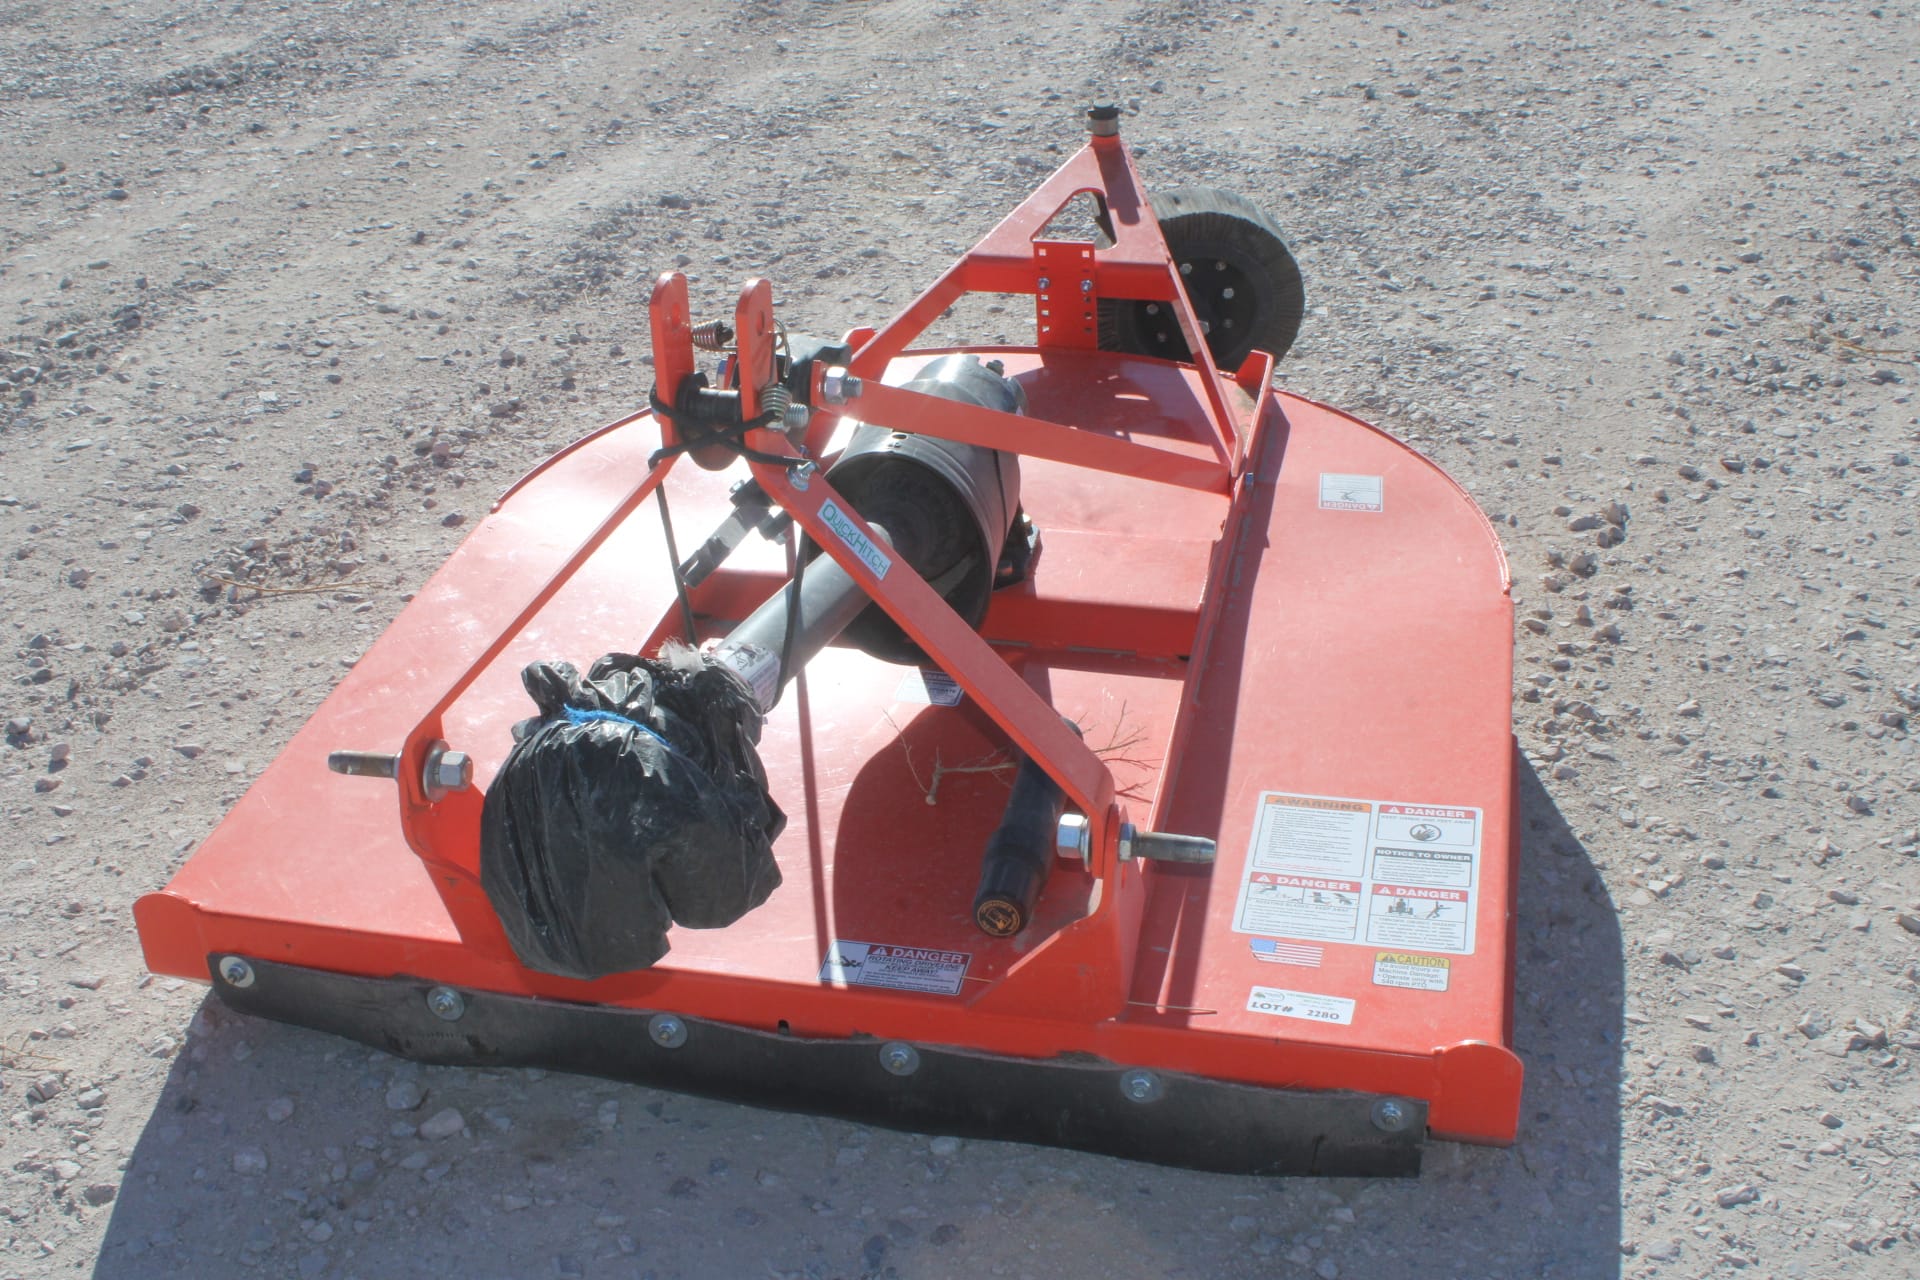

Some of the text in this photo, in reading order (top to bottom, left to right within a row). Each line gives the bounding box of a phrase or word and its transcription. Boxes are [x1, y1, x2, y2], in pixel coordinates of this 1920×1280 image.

[1288, 798, 1363, 811] WARNING
[1404, 807, 1465, 818] DANGER
[1376, 849, 1415, 858] NOTICE
[1433, 853, 1471, 861] OWNER
[1276, 876, 1351, 890] DANGER
[1396, 888, 1460, 900] DANGER
[891, 948, 963, 963] DANGER
[1397, 954, 1445, 967] CAUTION
[1251, 1001, 1294, 1012] LOT#
[1306, 1009, 1340, 1020] 2280
